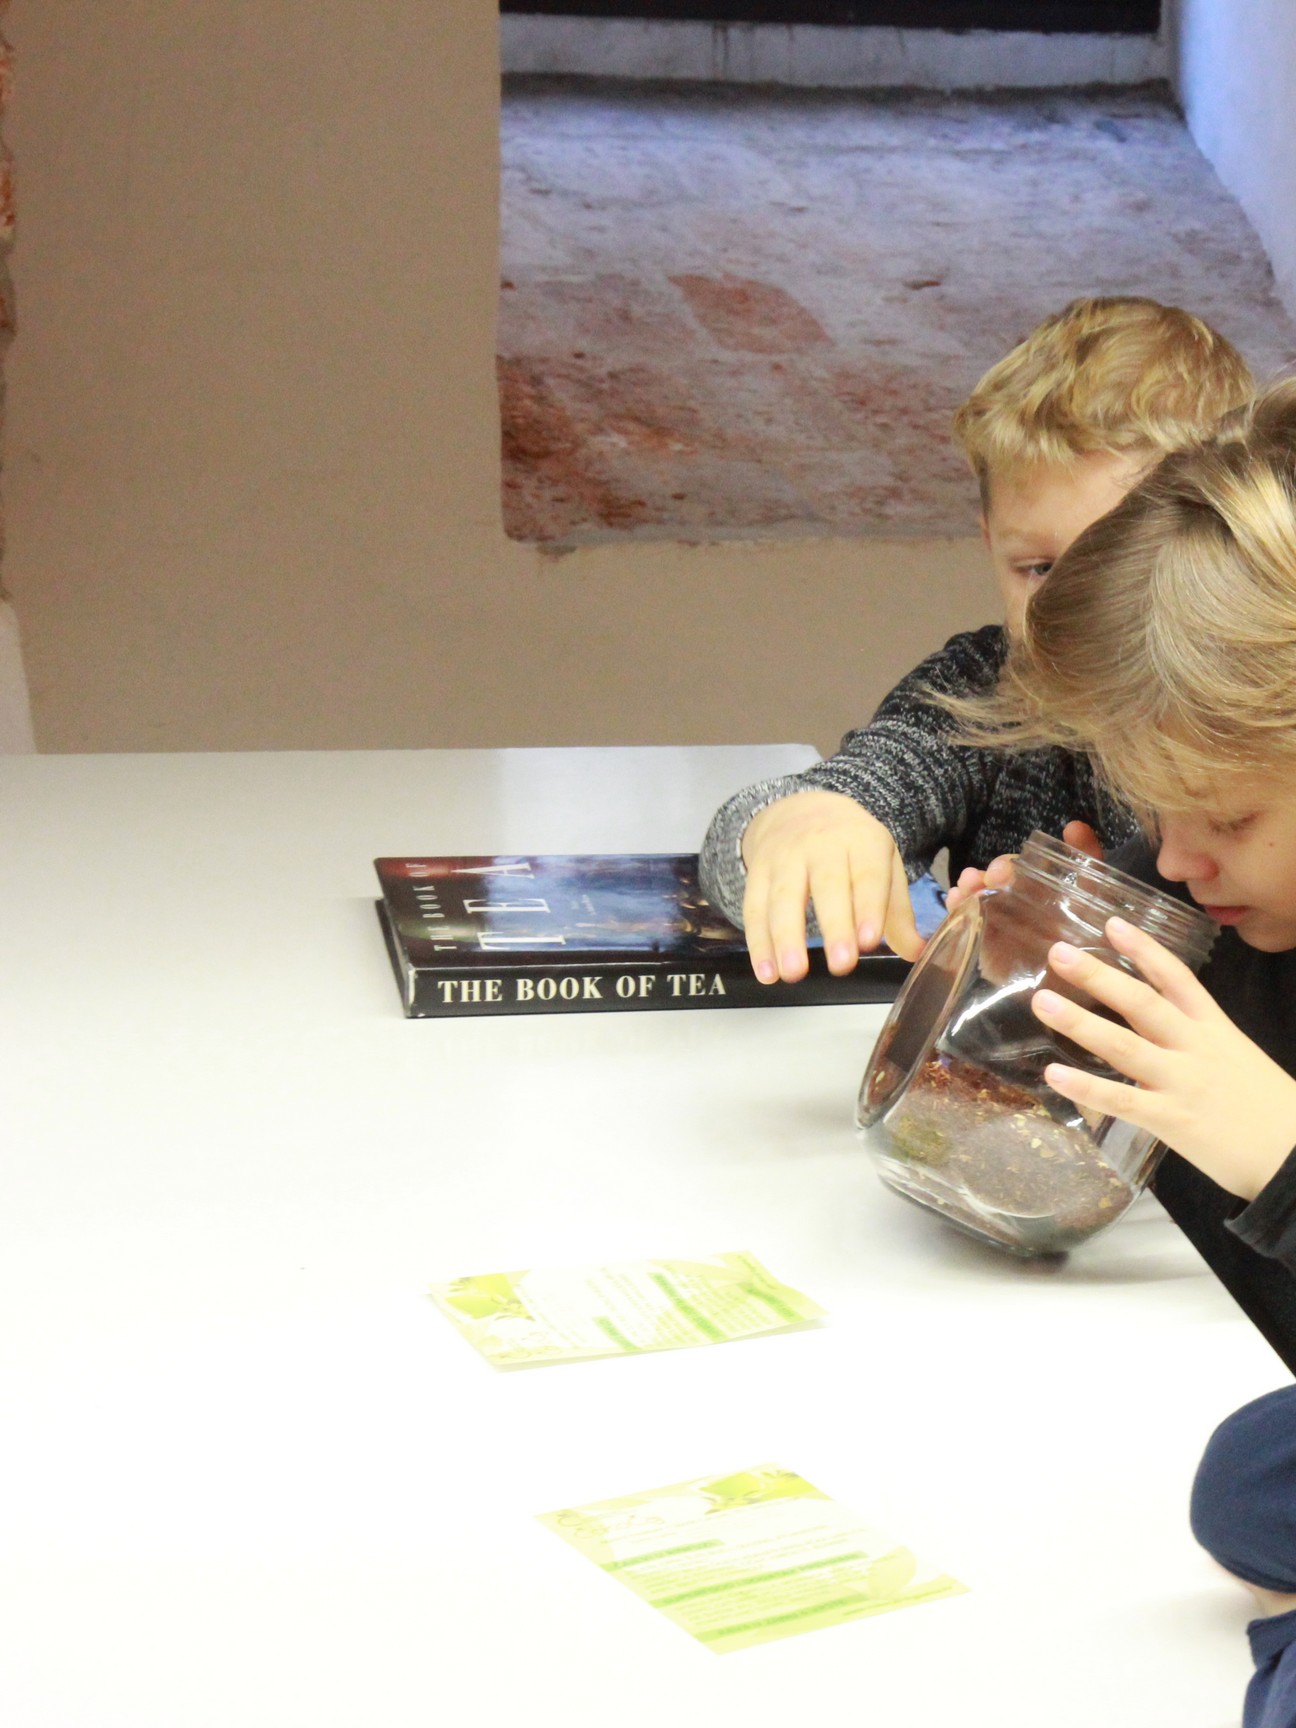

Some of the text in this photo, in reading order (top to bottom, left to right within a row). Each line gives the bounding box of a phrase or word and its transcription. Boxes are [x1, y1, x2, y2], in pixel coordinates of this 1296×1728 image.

[405, 862, 457, 951] THE BOOK OF
[450, 862, 566, 951] TEA
[437, 973, 727, 1003] THE BOOK OF TEA
